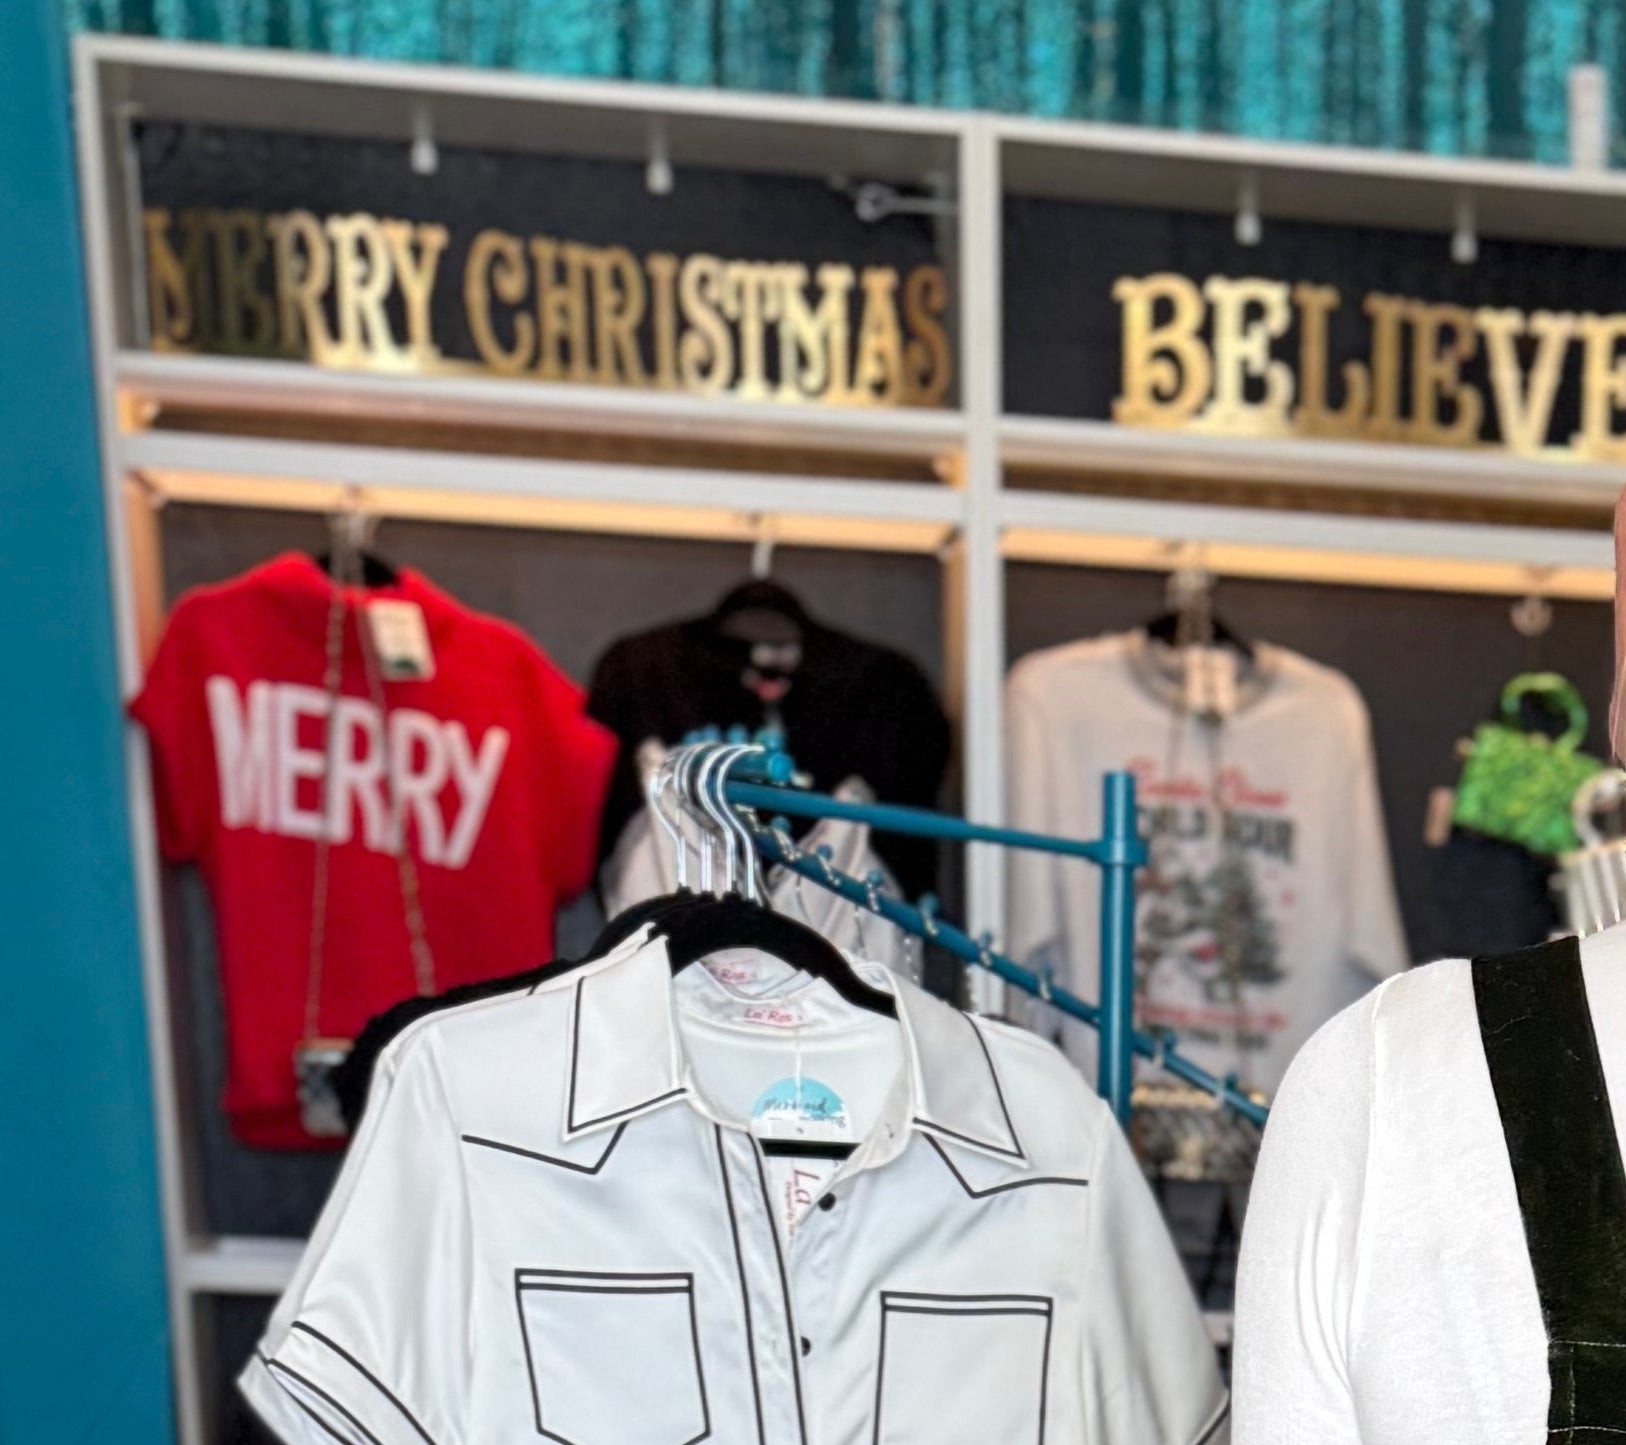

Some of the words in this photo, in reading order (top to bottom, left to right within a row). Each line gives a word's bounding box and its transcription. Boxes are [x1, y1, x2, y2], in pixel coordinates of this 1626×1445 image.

[144, 207, 449, 371] MERRY
[465, 228, 951, 402] CHRISTMAS
[205, 674, 511, 870] MERRY
